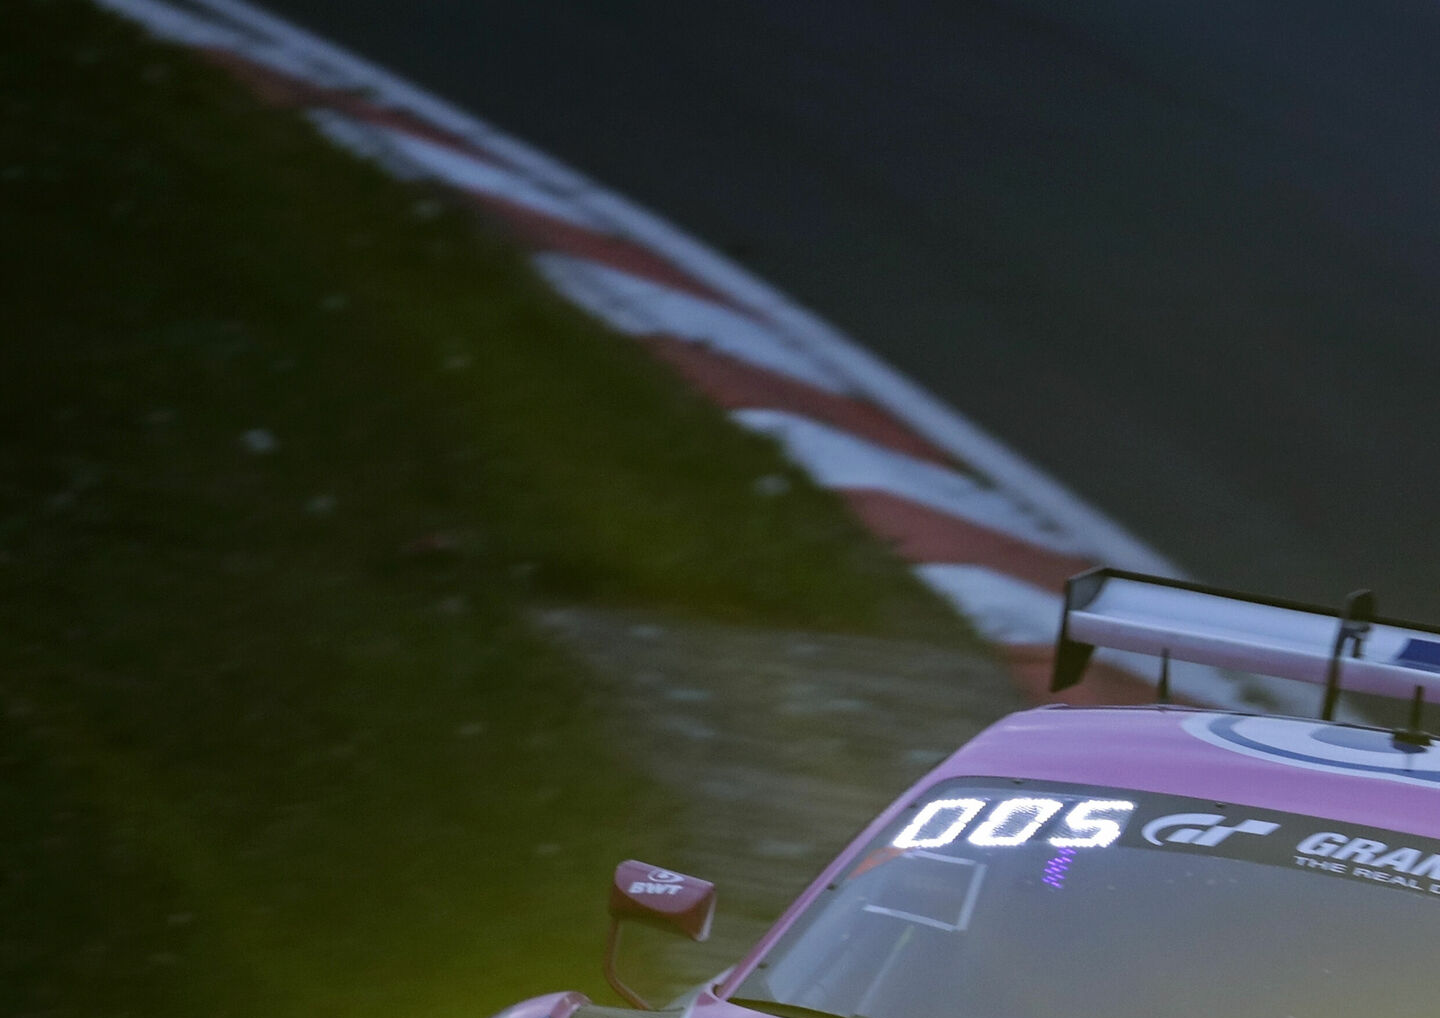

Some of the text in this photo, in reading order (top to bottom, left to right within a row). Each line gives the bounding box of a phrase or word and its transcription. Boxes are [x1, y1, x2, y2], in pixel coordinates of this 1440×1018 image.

[892, 799, 1134, 848] 005
[627, 882, 684, 896] BWT
[1293, 855, 1348, 874] THE
[1352, 867, 1424, 891] REAL
